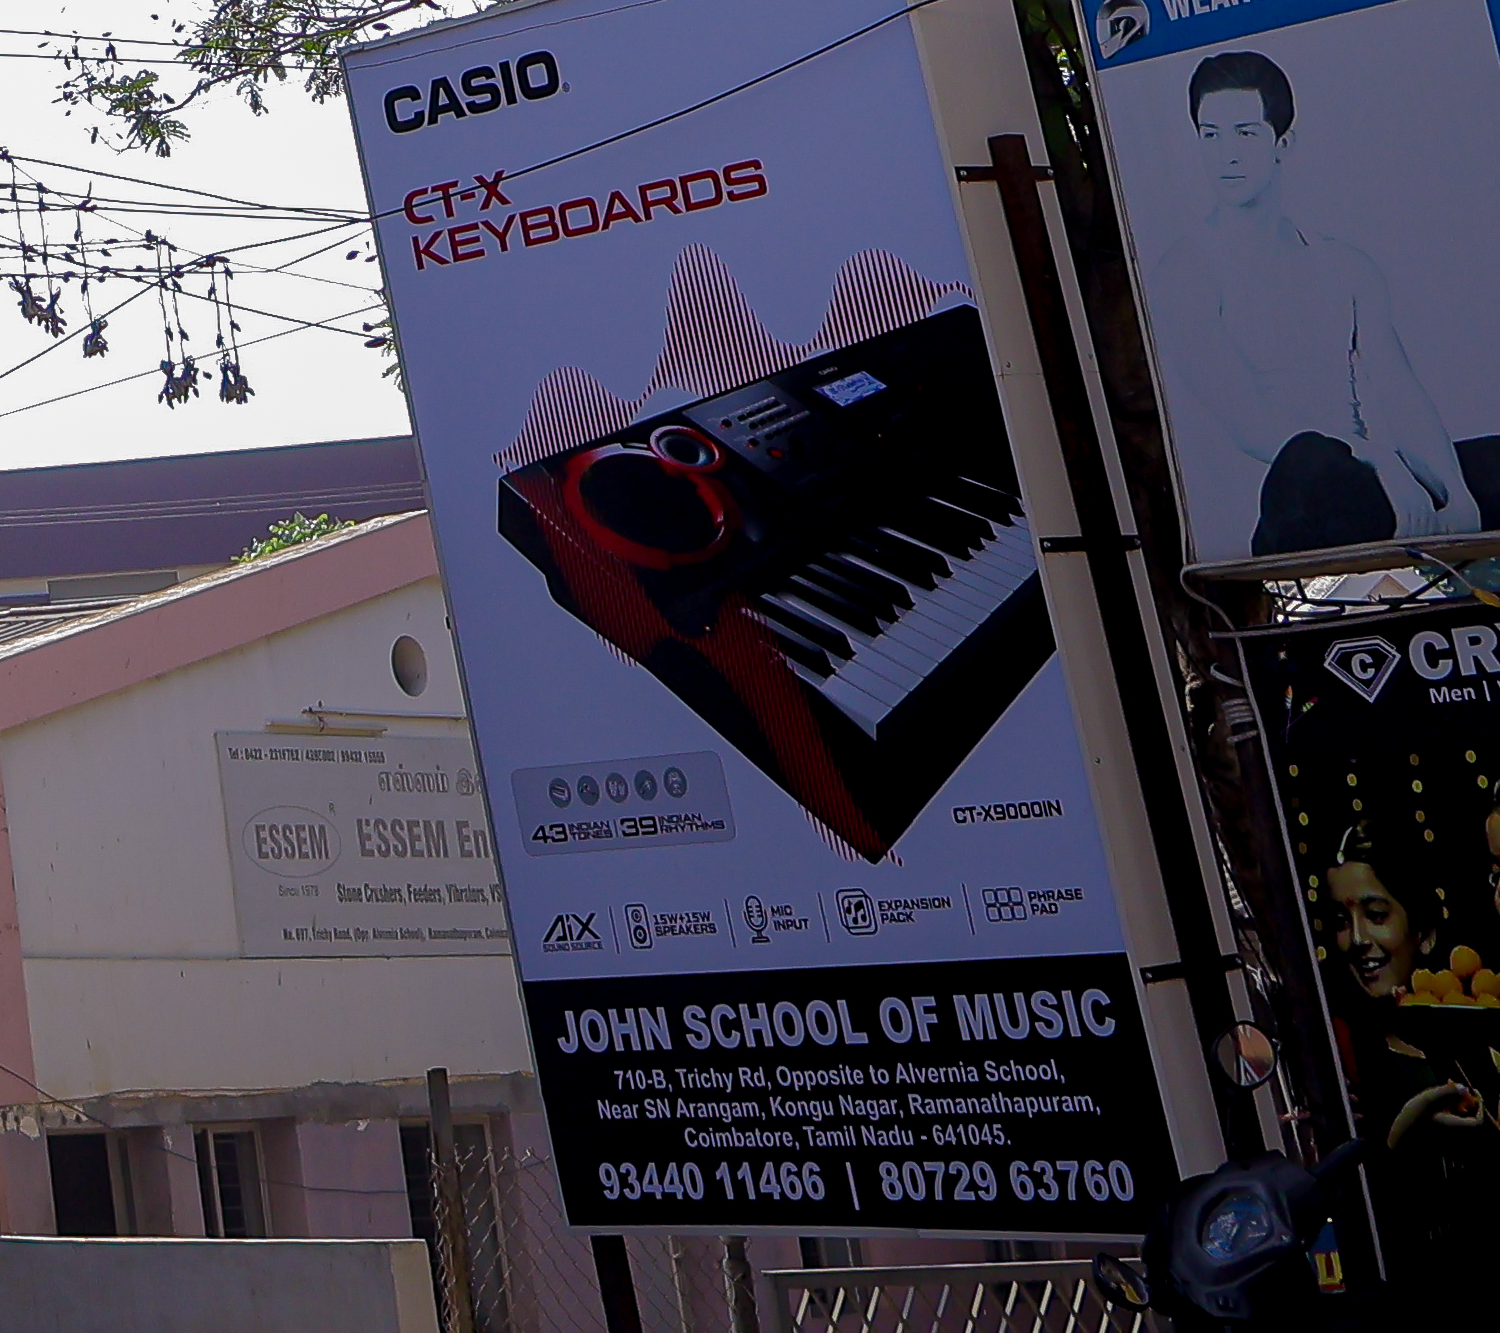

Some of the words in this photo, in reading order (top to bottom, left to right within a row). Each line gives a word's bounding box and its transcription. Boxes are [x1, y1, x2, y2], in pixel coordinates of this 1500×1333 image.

[382, 49, 561, 135] CASIO
[402, 168, 512, 226] CT-X
[410, 157, 769, 272] KEYBOARDS
[1428, 685, 1477, 705] Men
[952, 799, 1065, 824] CT-X9000IN
[255, 822, 330, 861] ESSEM
[355, 817, 450, 859] ESSEM
[531, 822, 570, 845] 43
[619, 815, 659, 838] 39
[878, 896, 952, 912] EXPANSION
[1027, 888, 1084, 903] PHRASE
[1030, 902, 1060, 916] PAD
[654, 921, 718, 937] SPEAKERS
[773, 918, 810, 931] INPUT
[880, 910, 916, 925] PACK
[556, 1006, 672, 1055] JOHN
[683, 997, 869, 1050] SCHOOL
[877, 994, 938, 1045] OF
[954, 988, 1117, 1041] MUSIC
[613, 1069, 673, 1093] 710-B,
[674, 1067, 733, 1093] Trichy
[737, 1066, 772, 1091] Rd,
[775, 1064, 865, 1091] Opposite
[869, 1064, 890, 1085] to
[896, 1060, 980, 1084] Alvernia
[983, 1058, 1066, 1084] School,
[597, 1098, 639, 1120] Near
[644, 1097, 672, 1120] SN
[676, 1097, 767, 1122] Arangam,
[769, 1095, 835, 1122] Kongu
[838, 1094, 904, 1121] Nagar,
[907, 1091, 1102, 1119] Ramanathapuram,
[683, 1126, 801, 1151] Coimbatore,
[802, 1125, 857, 1147] Tamil
[860, 1124, 914, 1147] Nadu
[931, 1123, 1012, 1146] 641045.
[600, 1160, 705, 1202] 93440
[714, 1159, 825, 1202] 11466
[880, 1158, 997, 1202] 80729
[1009, 1158, 1135, 1202] 63760
